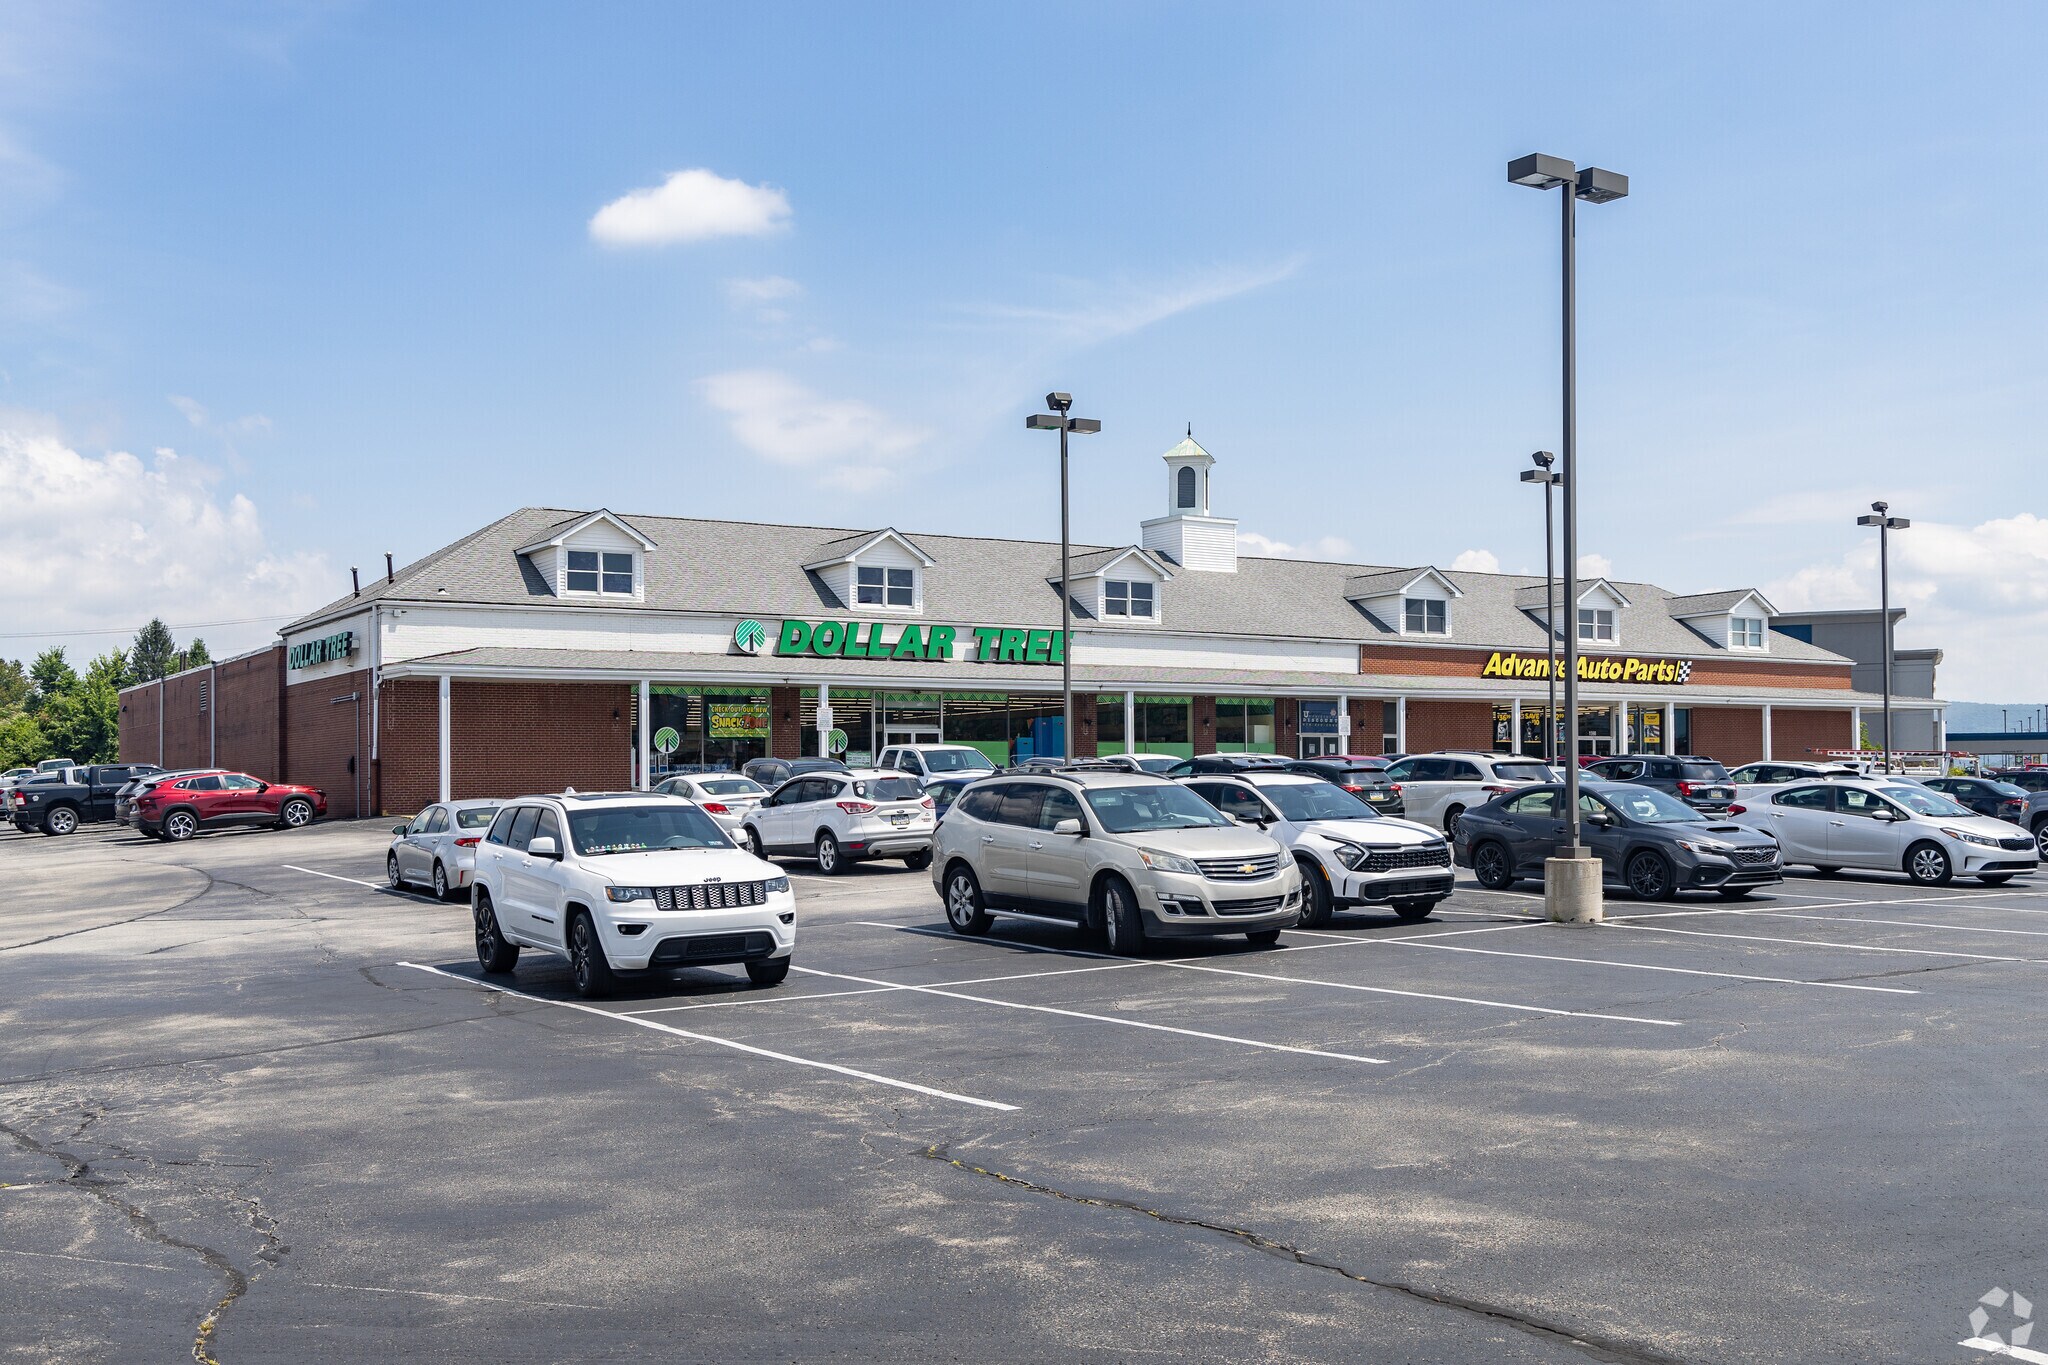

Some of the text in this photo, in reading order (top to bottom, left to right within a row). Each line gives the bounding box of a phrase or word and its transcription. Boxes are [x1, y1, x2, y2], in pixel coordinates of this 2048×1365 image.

[289, 631, 350, 670] DOLLAR TREE
[778, 619, 1074, 662] DOLLAR TREE
[1577, 656, 1622, 679] Auto
[1622, 658, 1675, 682] Parts
